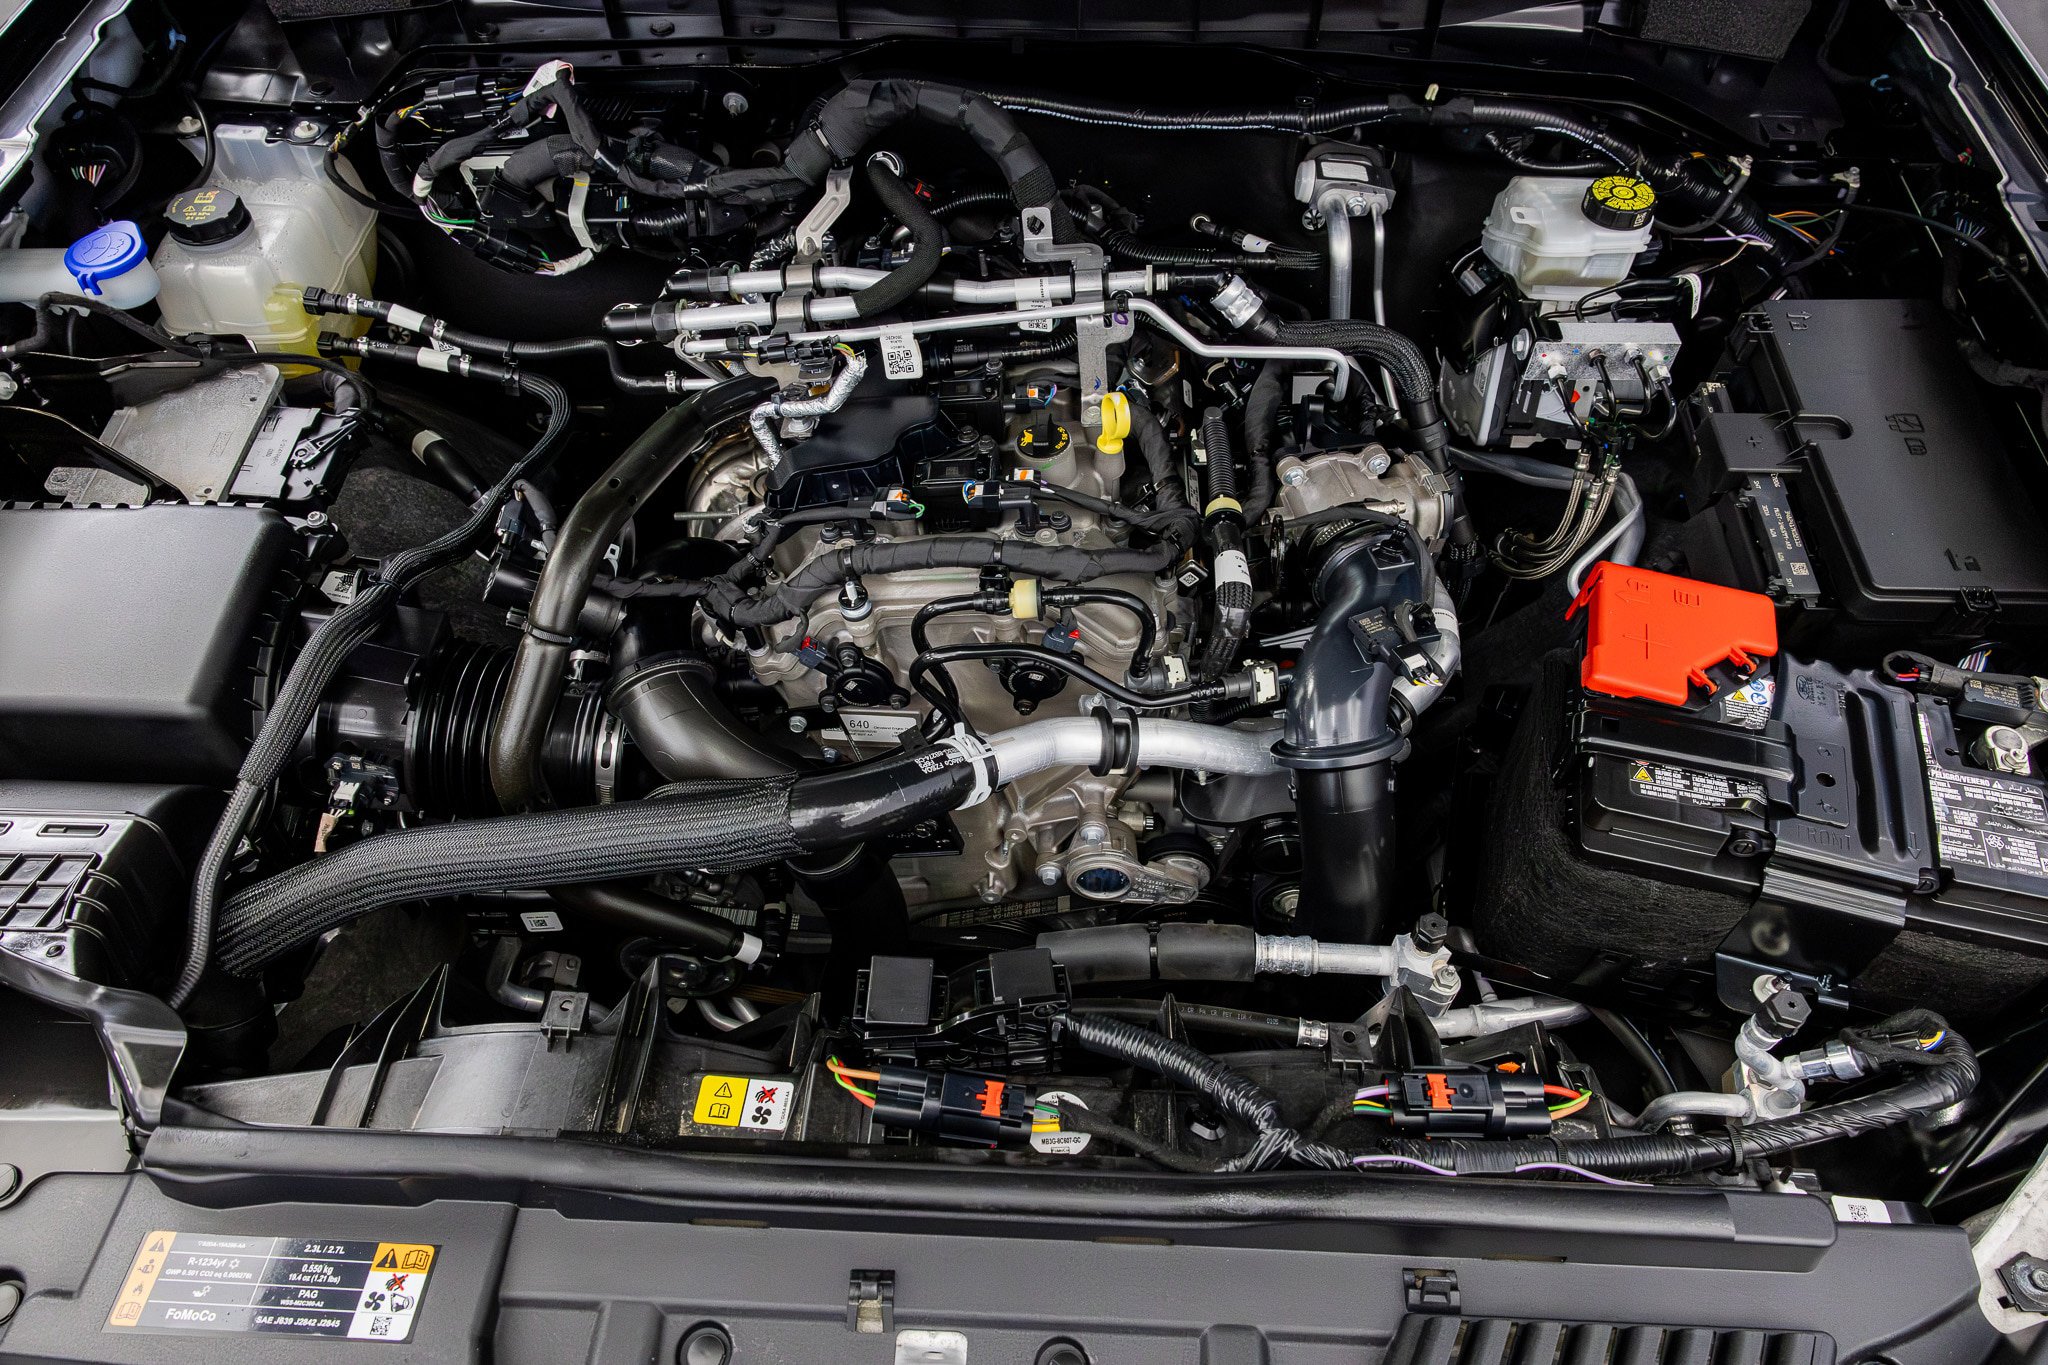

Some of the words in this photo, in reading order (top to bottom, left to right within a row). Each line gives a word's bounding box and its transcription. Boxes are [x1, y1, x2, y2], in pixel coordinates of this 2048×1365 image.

[363, 300, 374, 309] UPR
[371, 341, 389, 349] LWR
[849, 719, 870, 729] 640
[1931, 769, 1990, 787] PELIGRO/VENENO
[1797, 823, 1851, 851] FRONT
[304, 1244, 321, 1253] 2.3L
[327, 1245, 346, 1255] 2.7L
[187, 1256, 227, 1269] R-1234yf
[165, 1268, 182, 1276] GWP
[199, 1269, 214, 1277] CO2
[214, 1271, 222, 1279] eq
[301, 1263, 323, 1273] 0.550
[322, 1265, 334, 1276] kg
[288, 1272, 302, 1281] 19.4
[310, 1274, 327, 1284] (1.21
[327, 1275, 341, 1285] lbs)
[298, 1289, 319, 1299] PAG
[165, 1308, 217, 1321] FoMoCo
[255, 1315, 274, 1325] SAE
[273, 1317, 293, 1326] J639
[293, 1317, 317, 1327] J2842
[317, 1318, 341, 1328] J2845
